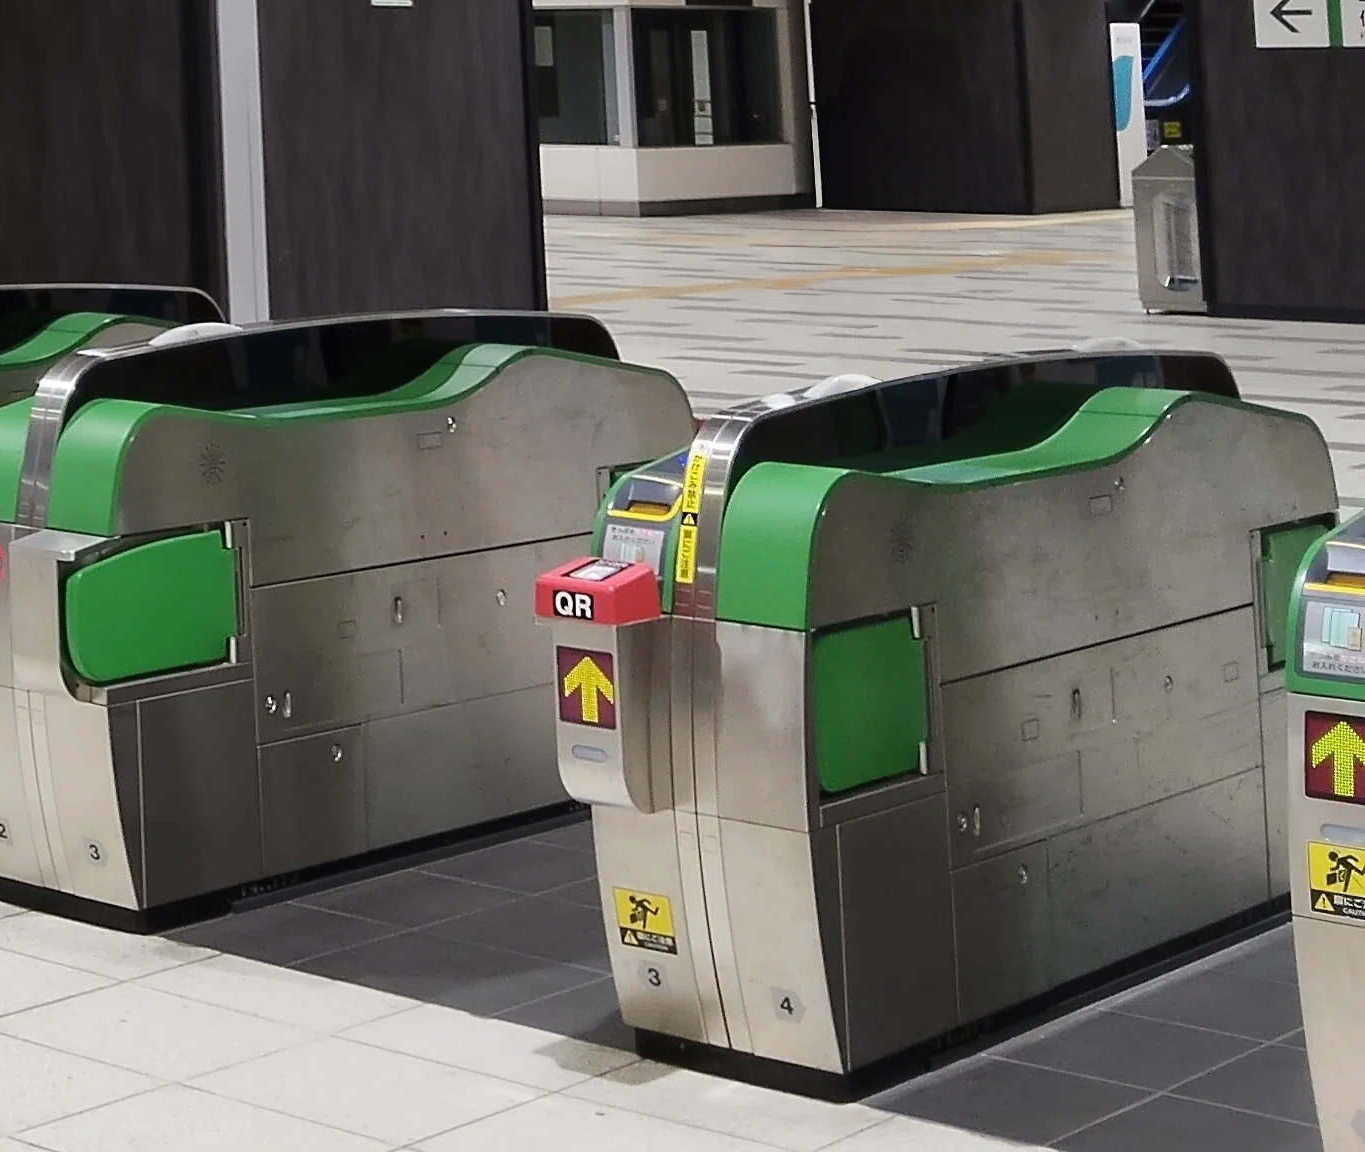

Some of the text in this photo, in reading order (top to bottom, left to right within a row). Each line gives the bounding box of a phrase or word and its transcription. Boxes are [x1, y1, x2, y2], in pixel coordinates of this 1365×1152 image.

[554, 591, 593, 619] QR
[89, 844, 101, 861] 3
[647, 968, 662, 987] 3
[780, 997, 795, 1015] 4
